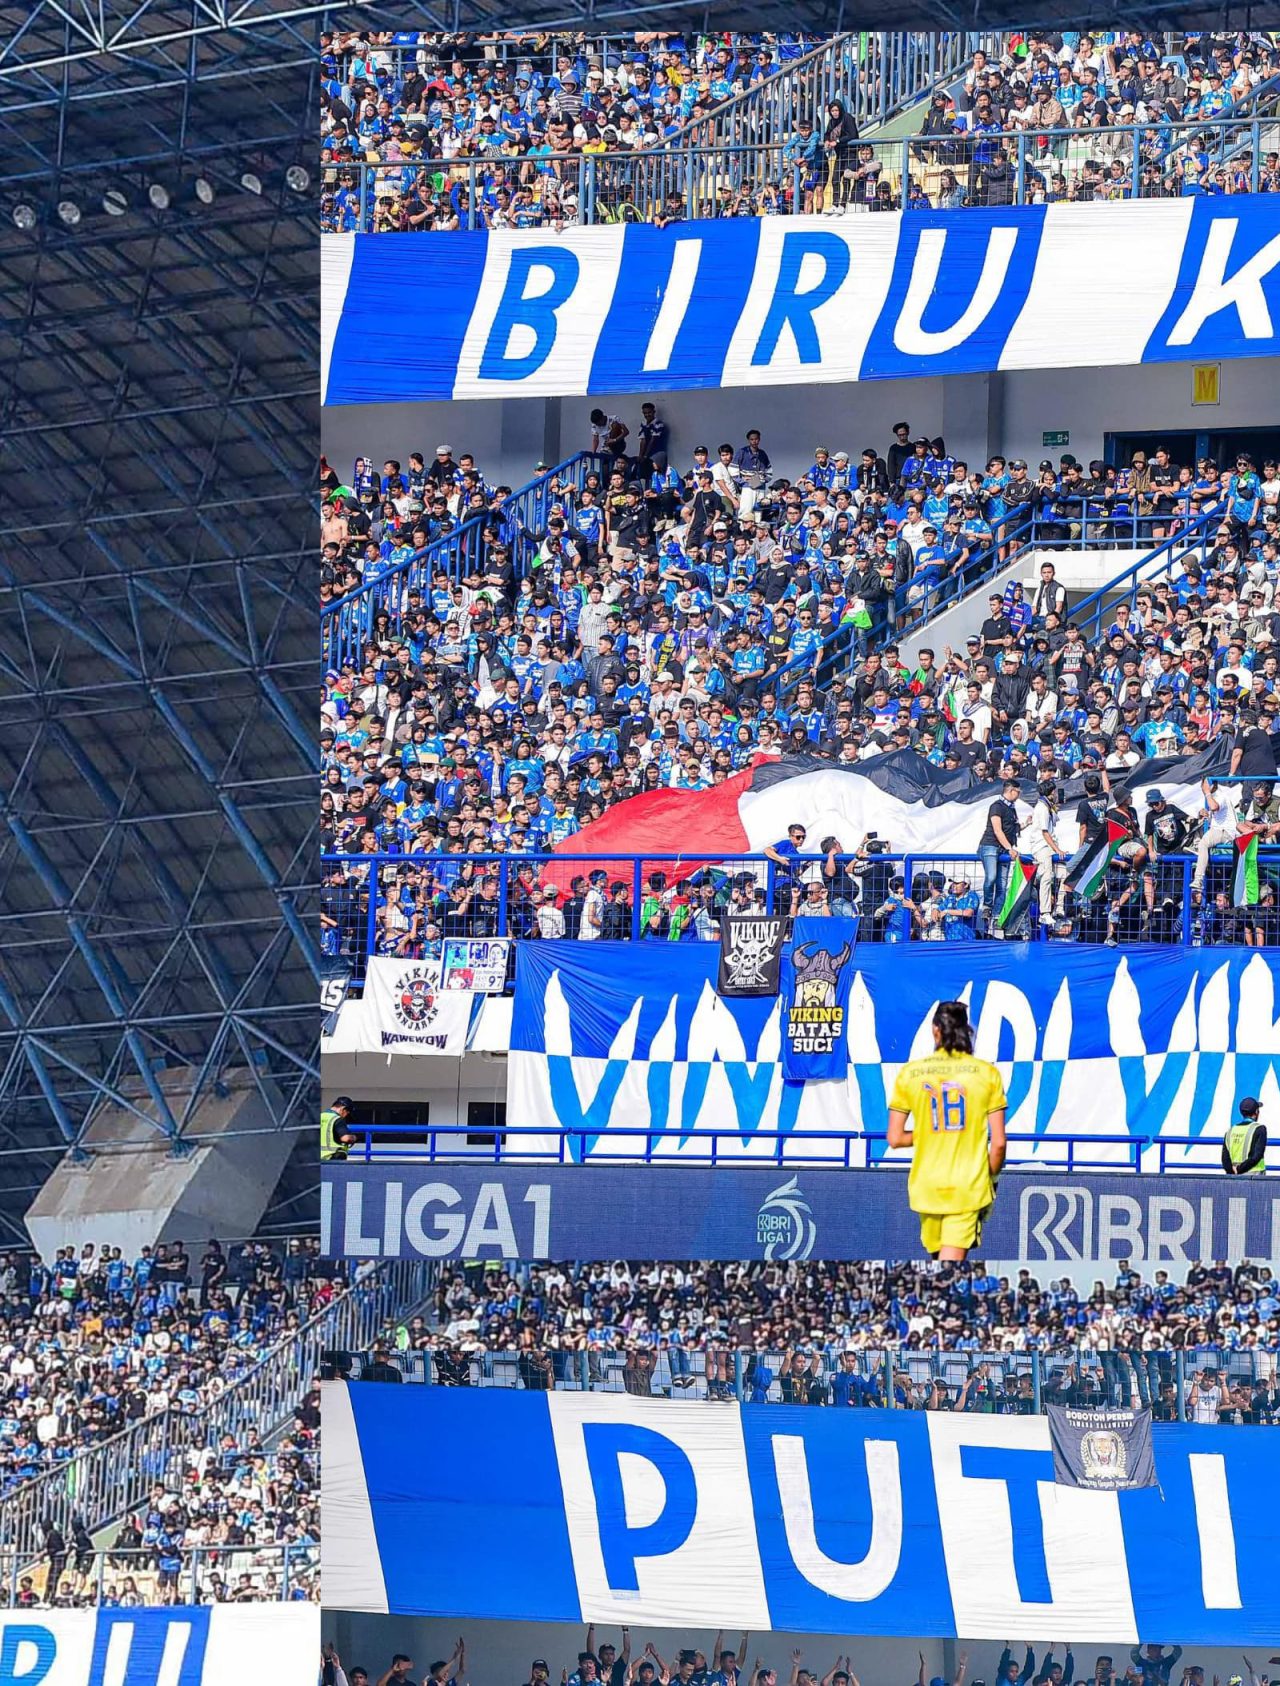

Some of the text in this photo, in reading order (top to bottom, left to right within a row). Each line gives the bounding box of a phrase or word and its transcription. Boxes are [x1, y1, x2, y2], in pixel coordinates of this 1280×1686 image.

[477, 227, 1018, 380] BIRU
[1198, 370, 1217, 401] M
[730, 921, 780, 948] VIKING
[489, 976, 504, 987] 97
[789, 1007, 843, 1022] VIKING
[787, 1023, 842, 1037] BATAS
[381, 1031, 448, 1050] WAWEWOW
[793, 1038, 833, 1052] SUCI
[847, 970, 1073, 1166] VDI
[923, 1082, 966, 1133] 18
[770, 1215, 791, 1231] BRI
[1106, 1412, 1135, 1421] PERSIB
